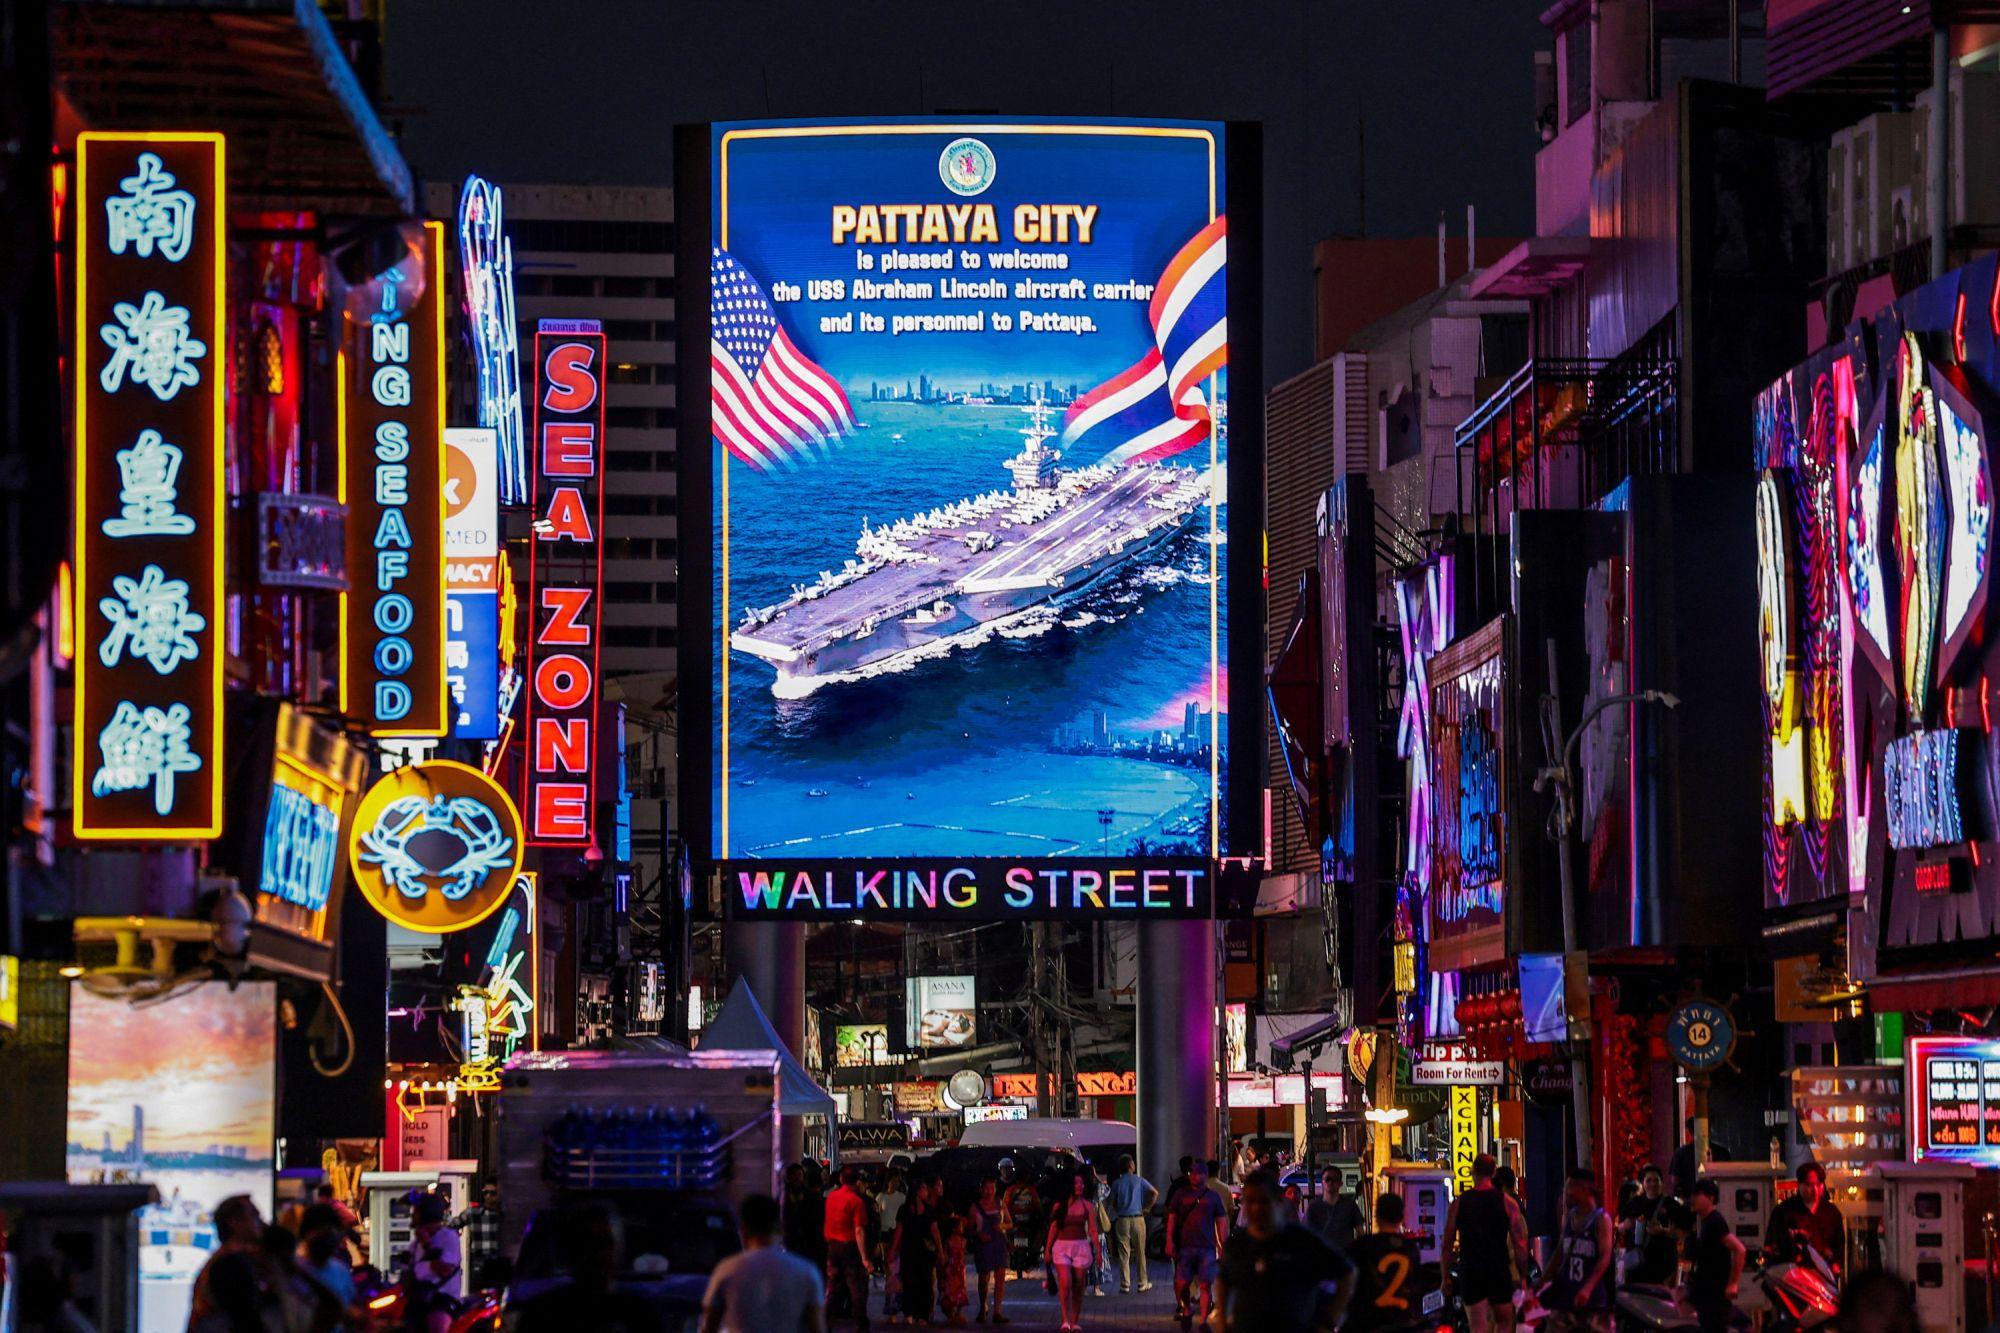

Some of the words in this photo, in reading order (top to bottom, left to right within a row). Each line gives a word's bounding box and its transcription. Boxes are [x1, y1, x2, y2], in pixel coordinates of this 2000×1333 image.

[832, 204, 1000, 244] PATTAYA
[1013, 204, 1098, 244] CITY
[881, 248, 953, 274] pleased
[960, 250, 981, 270] to
[988, 248, 1068, 270] welcome
[772, 281, 801, 302] the
[807, 279, 845, 301] USS
[852, 278, 933, 300] Abraham
[940, 277, 1007, 299] Lincoln
[1014, 277, 1086, 299] aircraft
[1093, 279, 1154, 301] carrier
[371, 267, 411, 408] ING
[820, 311, 853, 333] and
[892, 310, 984, 335] personnel
[991, 312, 1012, 332] to
[1019, 310, 1097, 335] Pattaya.
[541, 342, 598, 543] SEA
[92, 152, 207, 816] 南海皇海鮮
[373, 420, 414, 721] SEAFOOD
[533, 587, 594, 839] ZONE
[737, 868, 978, 912] WALKING
[1003, 866, 1206, 910] STREET
[931, 980, 966, 991] ASANA
[1690, 1027, 1707, 1041] 14
[1680, 1044, 1721, 1060] PATTAYA
[1001, 1079, 1136, 1094] EXANGE
[1416, 1067, 1444, 1079] Room
[1446, 1067, 1463, 1079] For
[1464, 1067, 1488, 1080] Rent
[1456, 1086, 1474, 1196] XCHANGE
[1374, 1252, 1410, 1311] 2
[1569, 1256, 1585, 1283] 13
